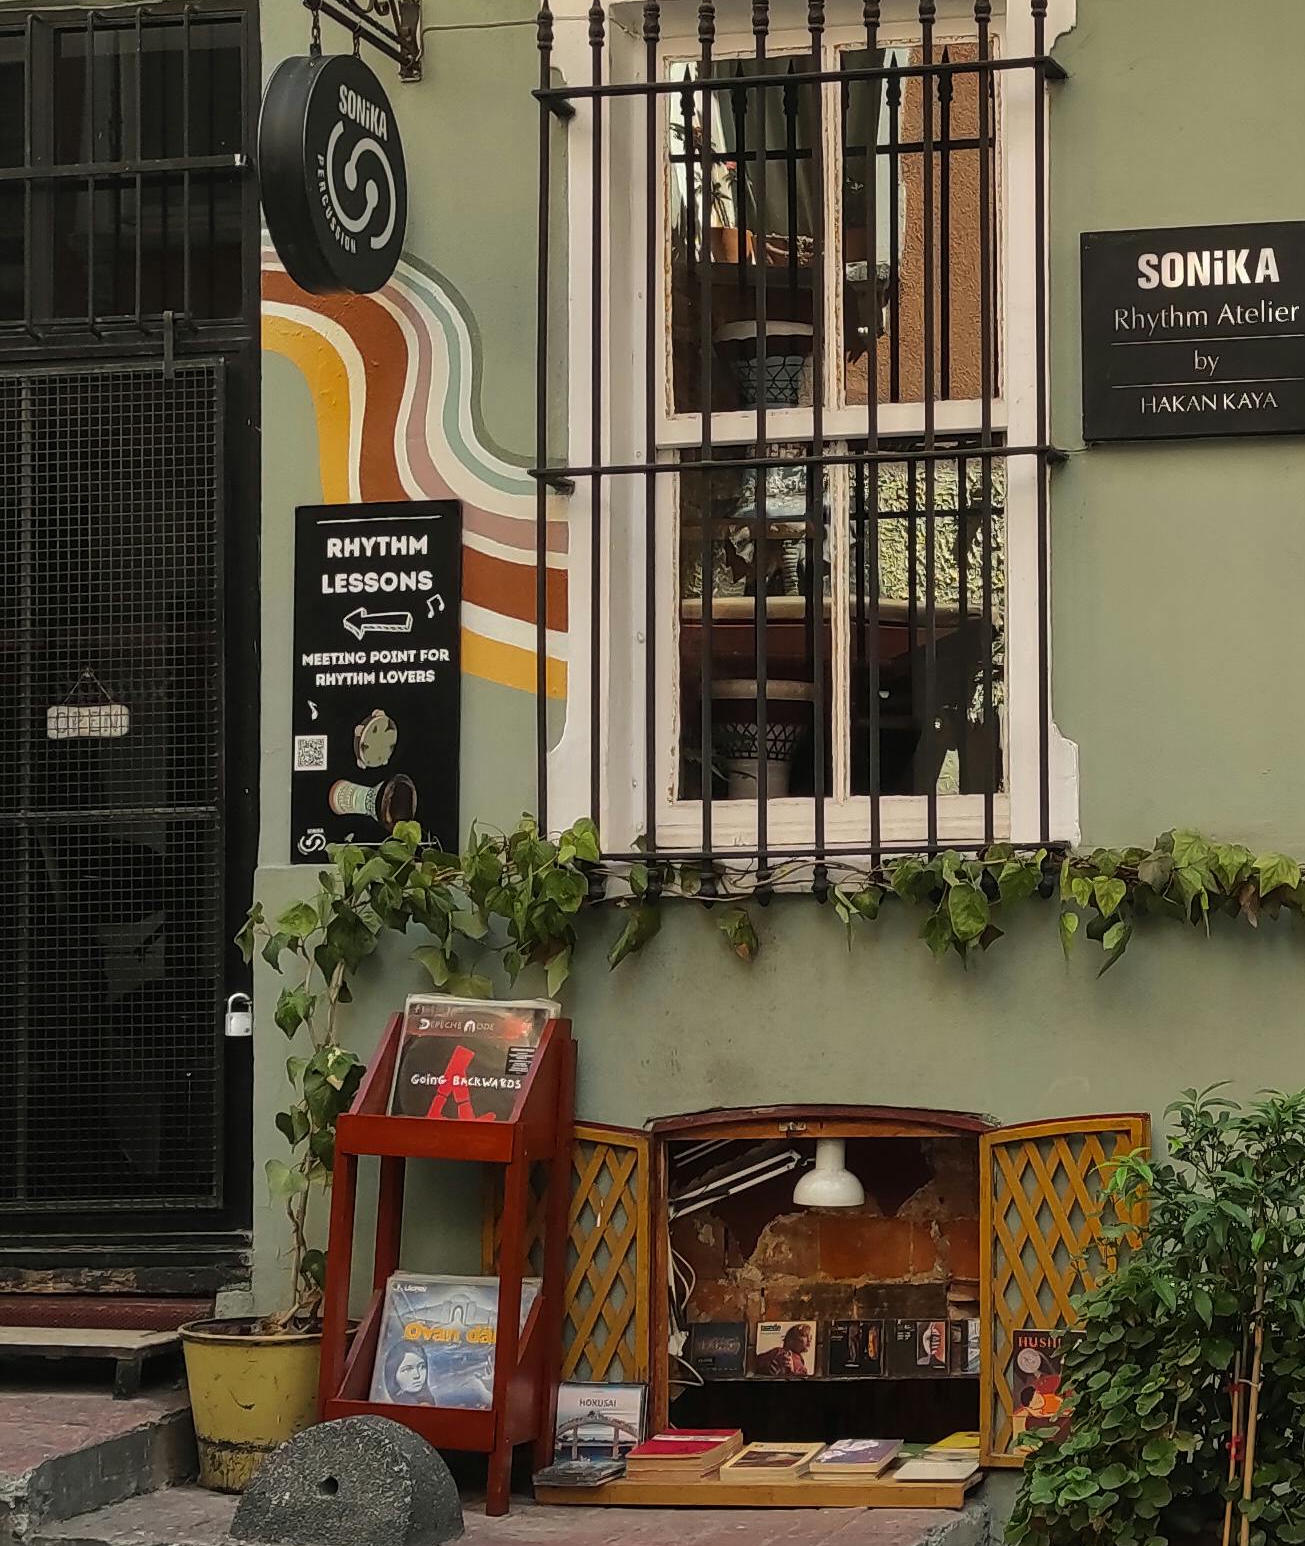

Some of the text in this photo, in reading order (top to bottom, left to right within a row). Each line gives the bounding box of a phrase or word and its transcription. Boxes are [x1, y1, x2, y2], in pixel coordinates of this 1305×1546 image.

[317, 154, 357, 254] PERCUSSION
[1137, 247, 1281, 290] SONiKA
[1114, 299, 1301, 336] Rhythm Atelier
[1193, 349, 1219, 377] by
[1141, 391, 1279, 414] HAKAN KAYA
[326, 534, 429, 559] RHYTHM
[321, 570, 434, 595] LESSONS
[302, 648, 450, 668] MEETING POINT FOR
[315, 669, 436, 687] RHYTHM LOVERS
[452, 1074, 522, 1090] BACKWARDS
[579, 1398, 617, 1408] HOKUSAI
